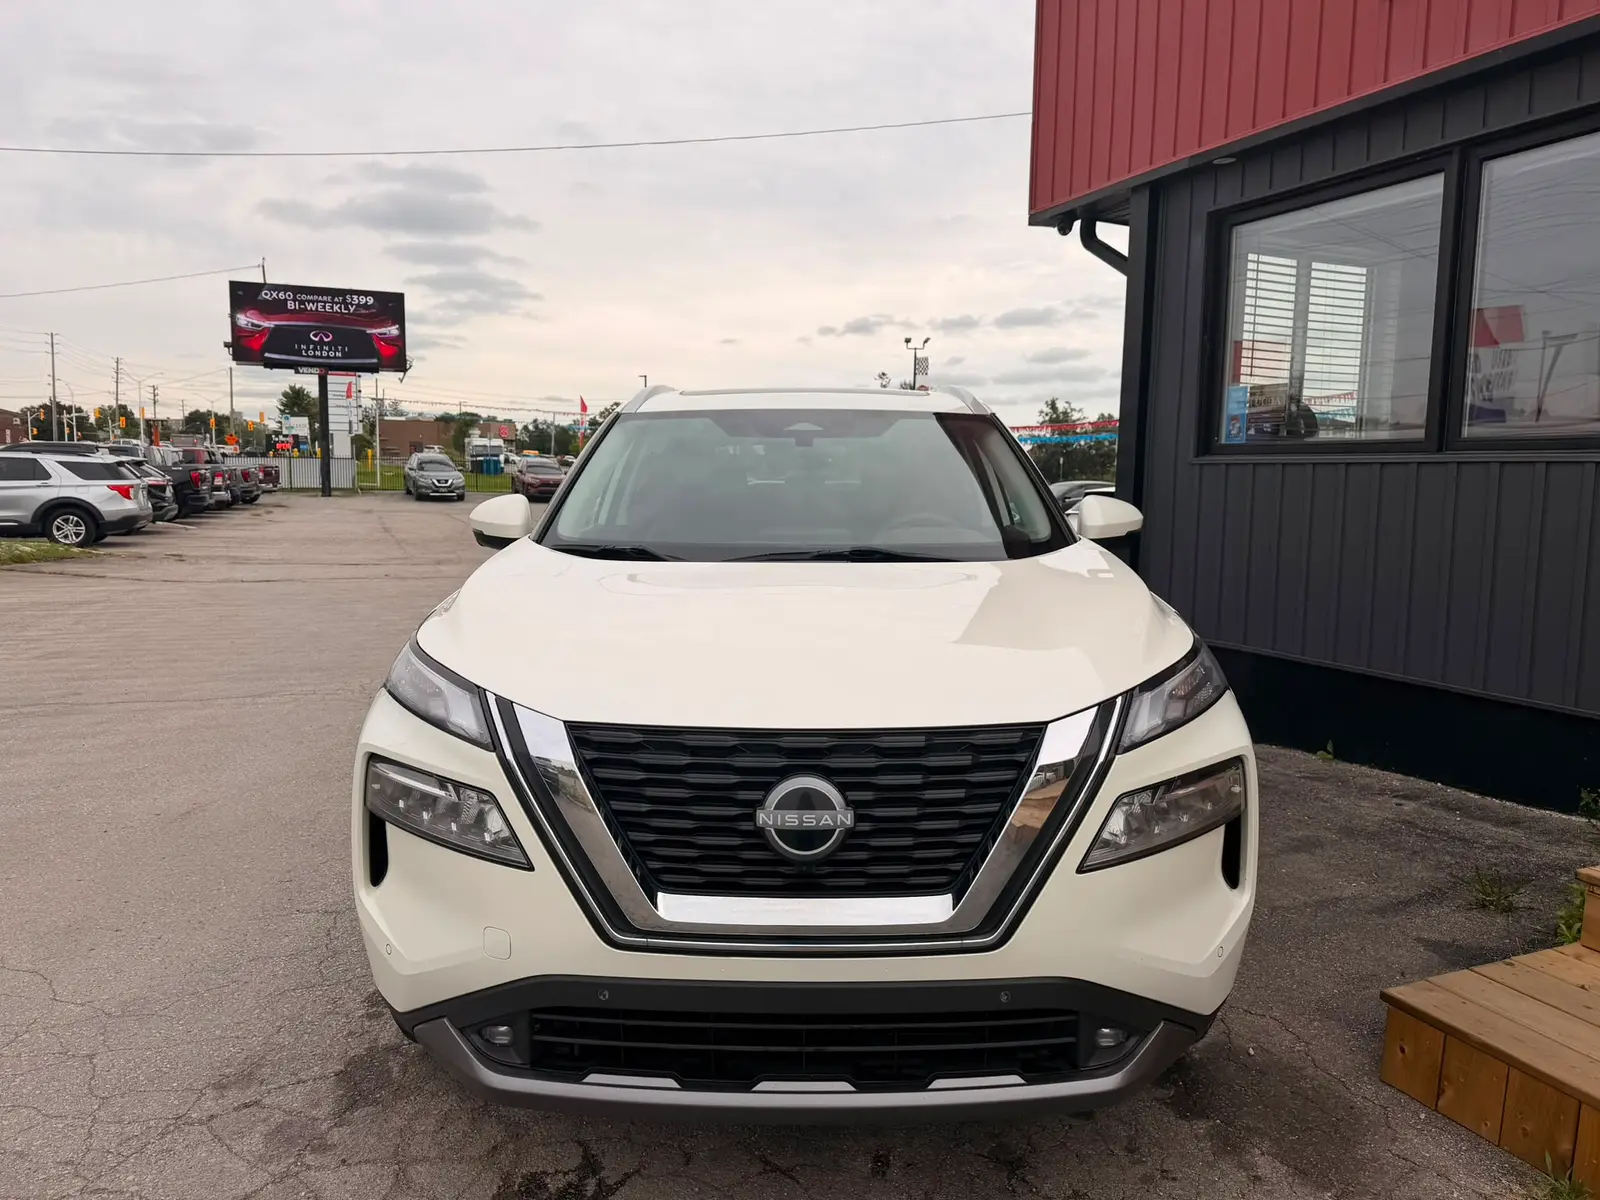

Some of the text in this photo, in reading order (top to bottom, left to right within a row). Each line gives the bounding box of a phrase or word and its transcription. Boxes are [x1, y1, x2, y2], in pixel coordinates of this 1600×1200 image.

[261, 290, 293, 300] QX60
[296, 293, 332, 302] COMPARE
[345, 294, 374, 305] $399
[287, 300, 356, 313] BI-WEEKLY
[294, 343, 348, 352] INFINITI
[759, 813, 851, 826] NISSAN
